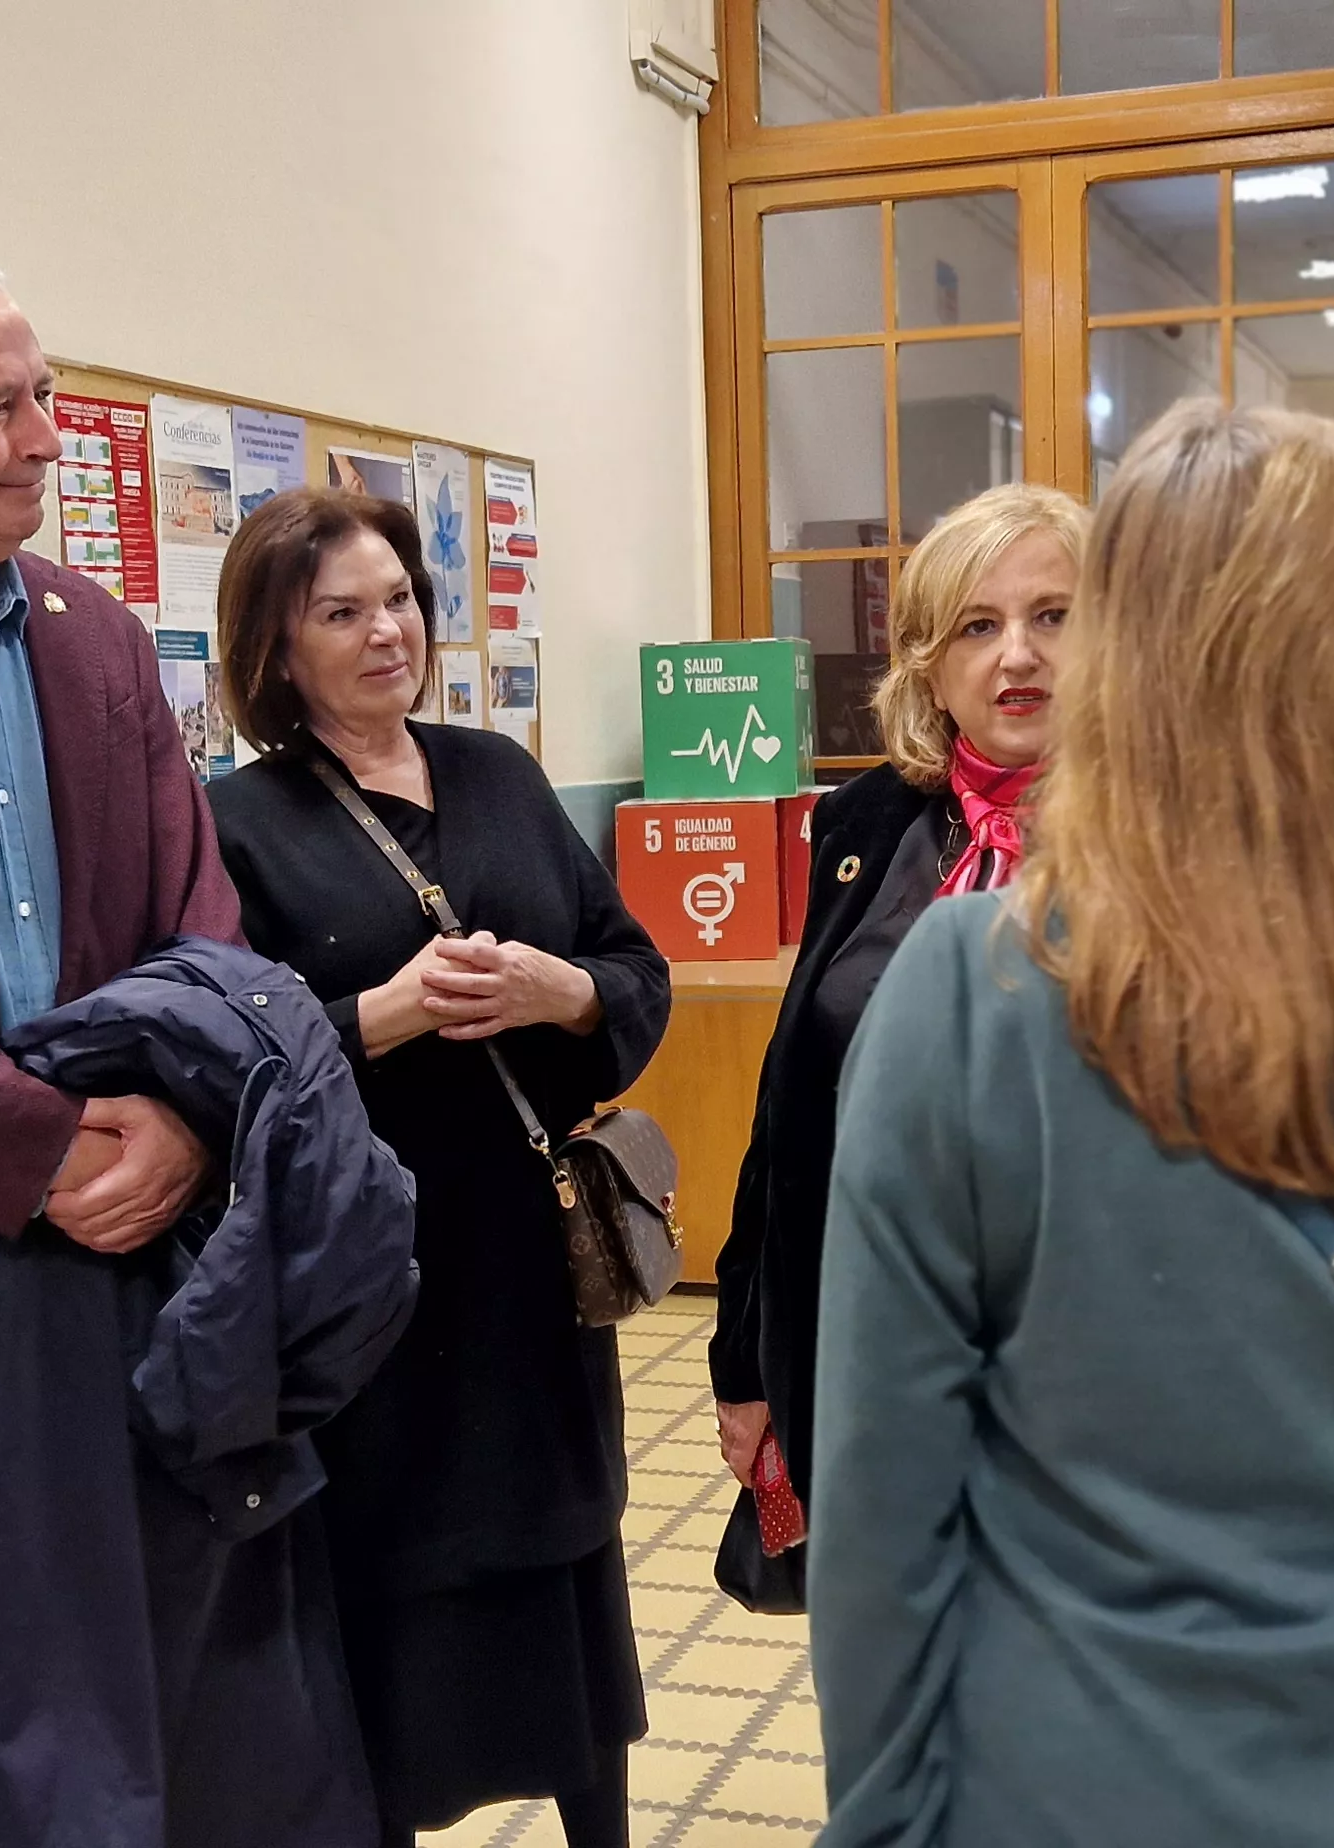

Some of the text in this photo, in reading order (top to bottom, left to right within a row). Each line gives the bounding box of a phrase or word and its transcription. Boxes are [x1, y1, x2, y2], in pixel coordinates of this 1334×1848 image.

[163, 421, 222, 446] Conferencias
[684, 657, 723, 674] SALUD
[656, 658, 674, 695] 3
[684, 676, 758, 694] Y BIENESTAR
[645, 819, 662, 853] 5
[675, 817, 732, 834] IGUALDAD
[800, 811, 812, 844] 4
[676, 834, 737, 852] DE GÉNERO
